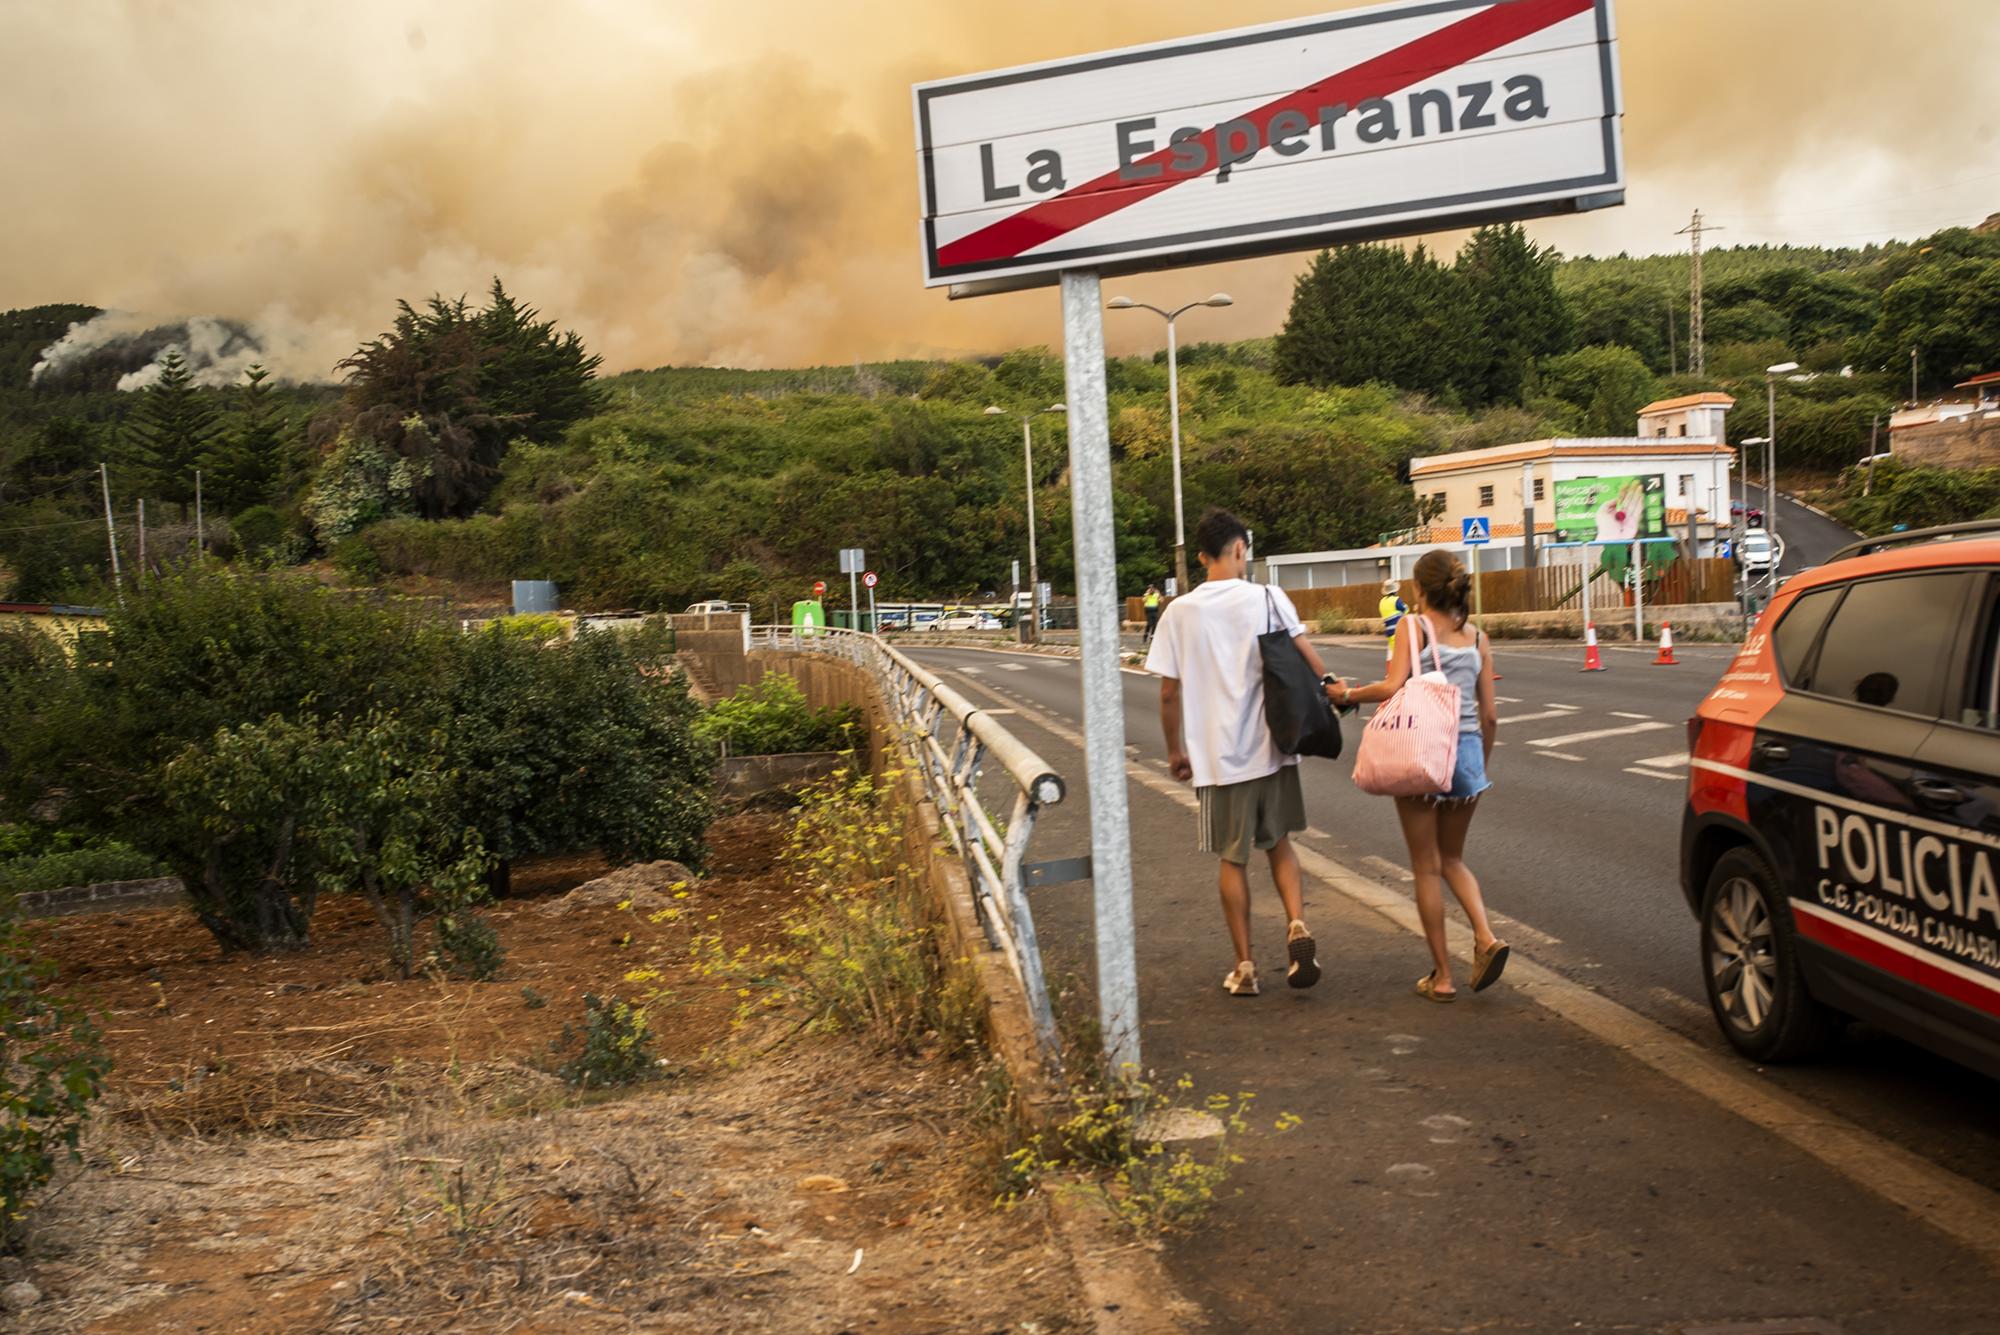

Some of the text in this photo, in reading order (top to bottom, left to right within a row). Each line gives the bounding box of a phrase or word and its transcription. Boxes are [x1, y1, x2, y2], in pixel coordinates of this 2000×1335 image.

[979, 73, 1549, 202] La Esperanza
[1815, 805, 2000, 929] POLICIA
[1818, 879, 1851, 910] C.G.
[1853, 891, 1919, 937] POLICIA
